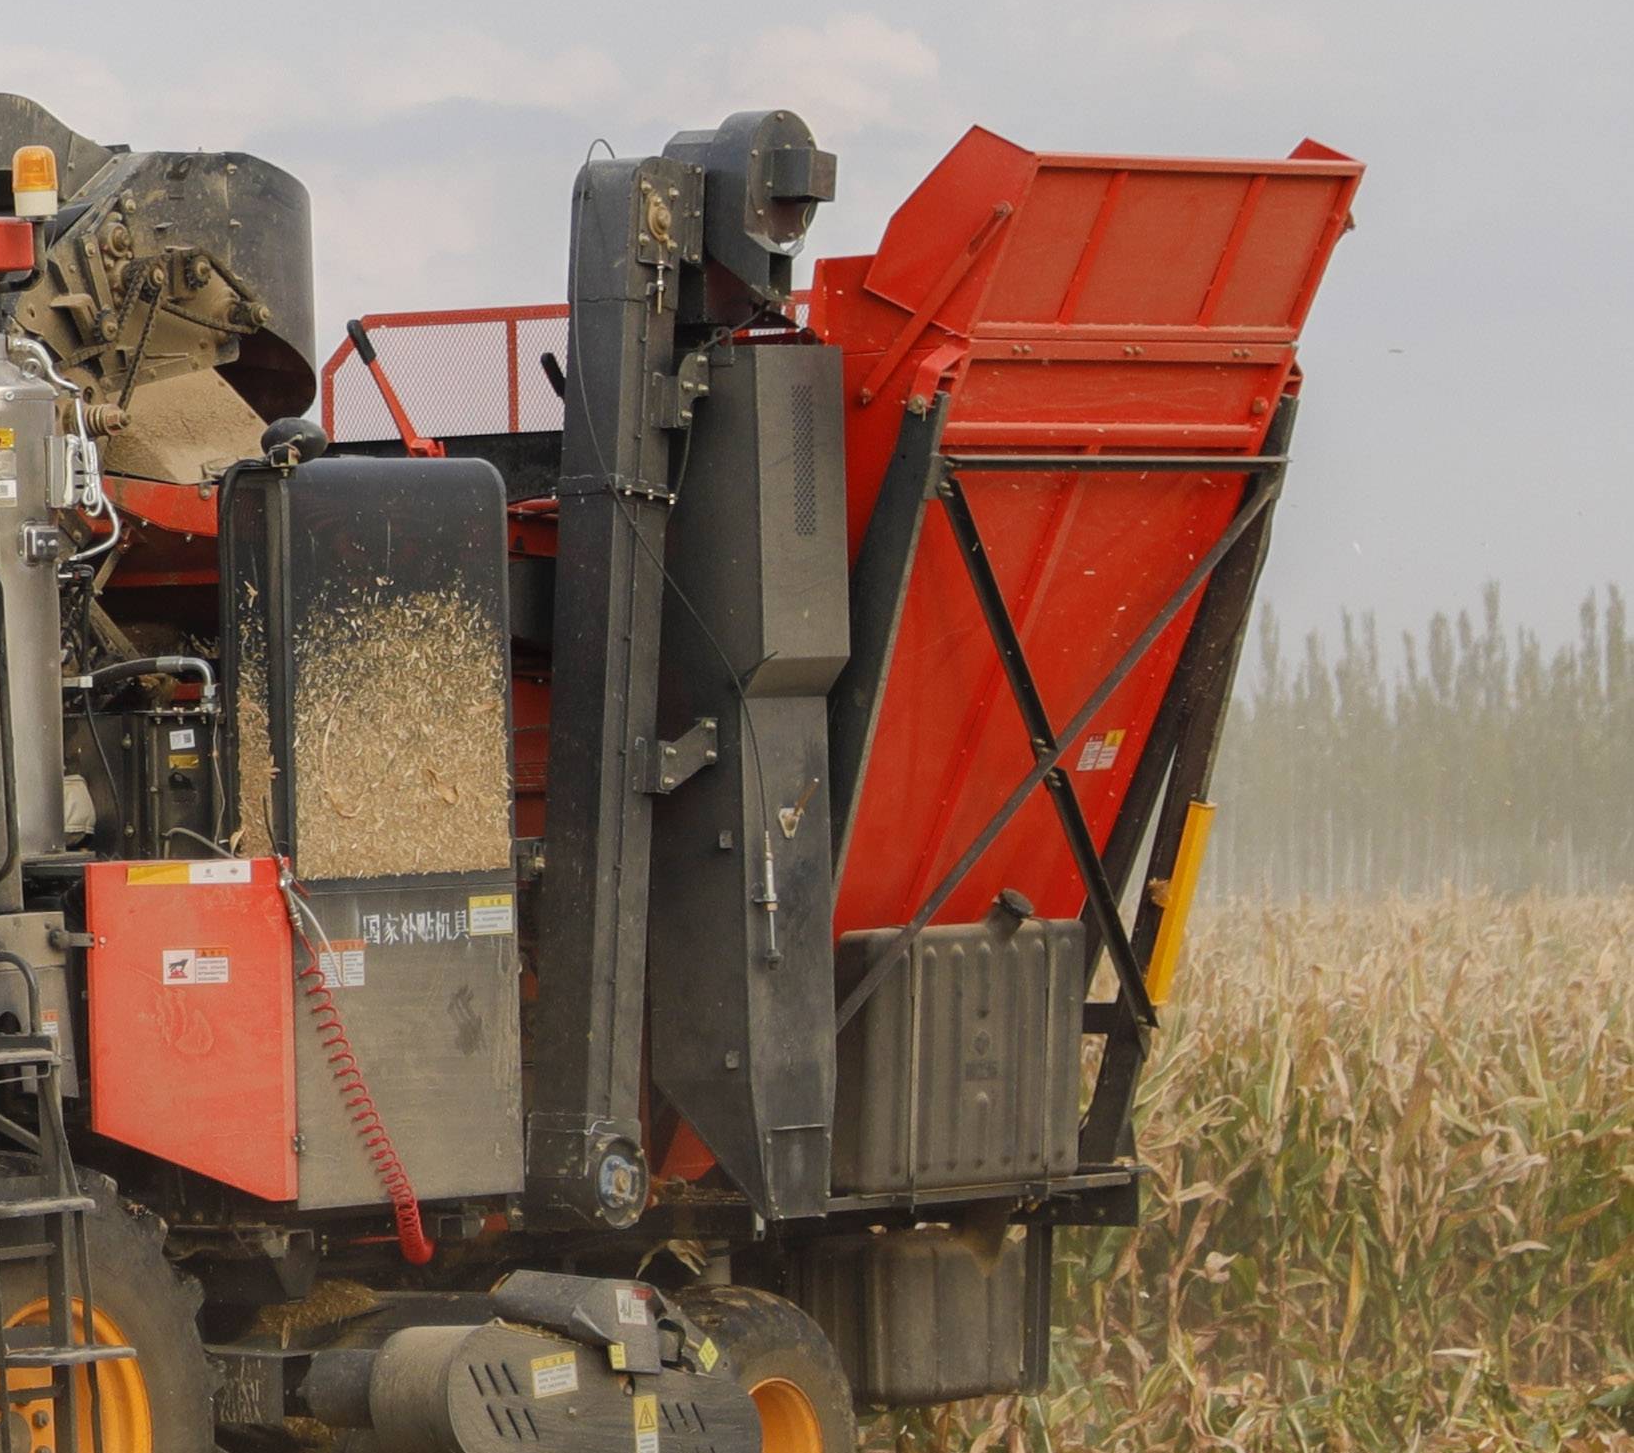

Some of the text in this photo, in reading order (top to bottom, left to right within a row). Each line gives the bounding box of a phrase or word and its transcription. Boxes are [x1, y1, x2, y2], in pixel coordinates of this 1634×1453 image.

[362, 909, 470, 945] 国家补贴机具
